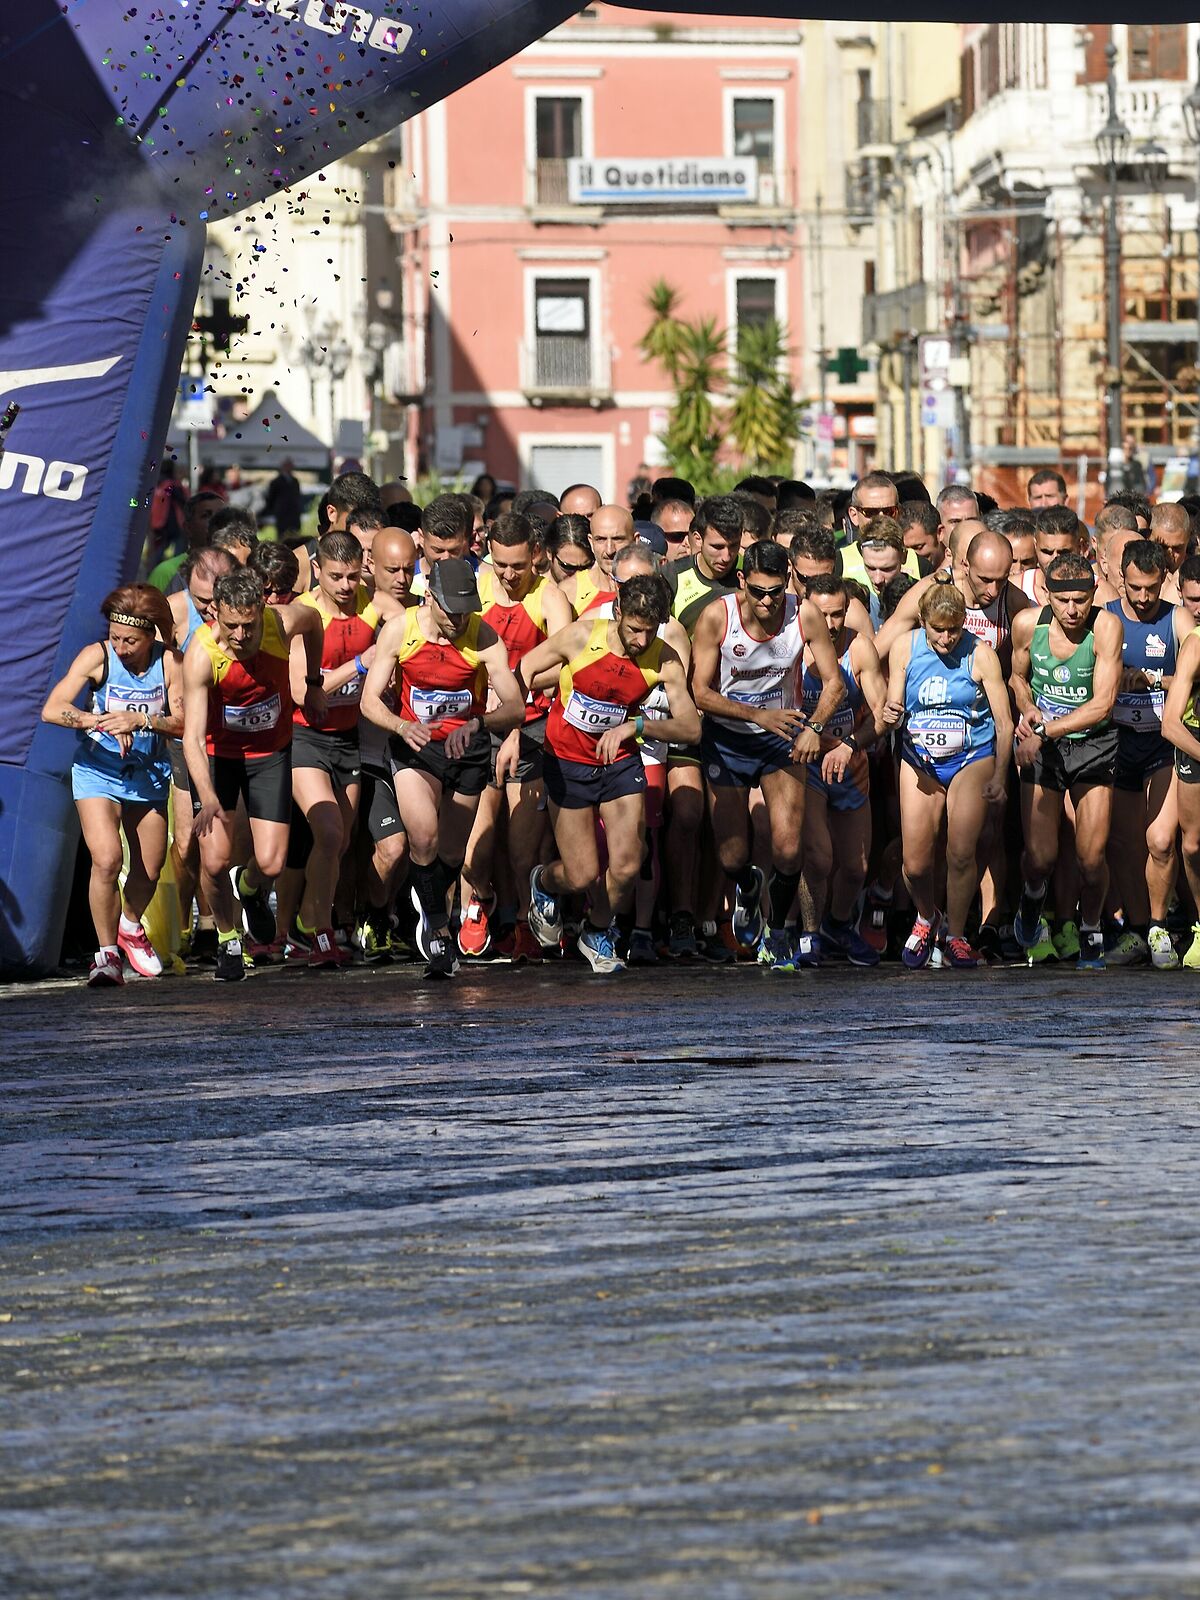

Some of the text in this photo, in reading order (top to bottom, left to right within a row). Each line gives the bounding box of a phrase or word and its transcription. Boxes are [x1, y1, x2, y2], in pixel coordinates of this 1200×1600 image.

[578, 163, 747, 187] il Quotidiano
[1043, 683, 1088, 697] AIELLO
[425, 703, 459, 716] 105
[1131, 709, 1142, 722] 3
[238, 711, 272, 727] 103
[579, 709, 611, 726] 104
[925, 733, 947, 746] 58
